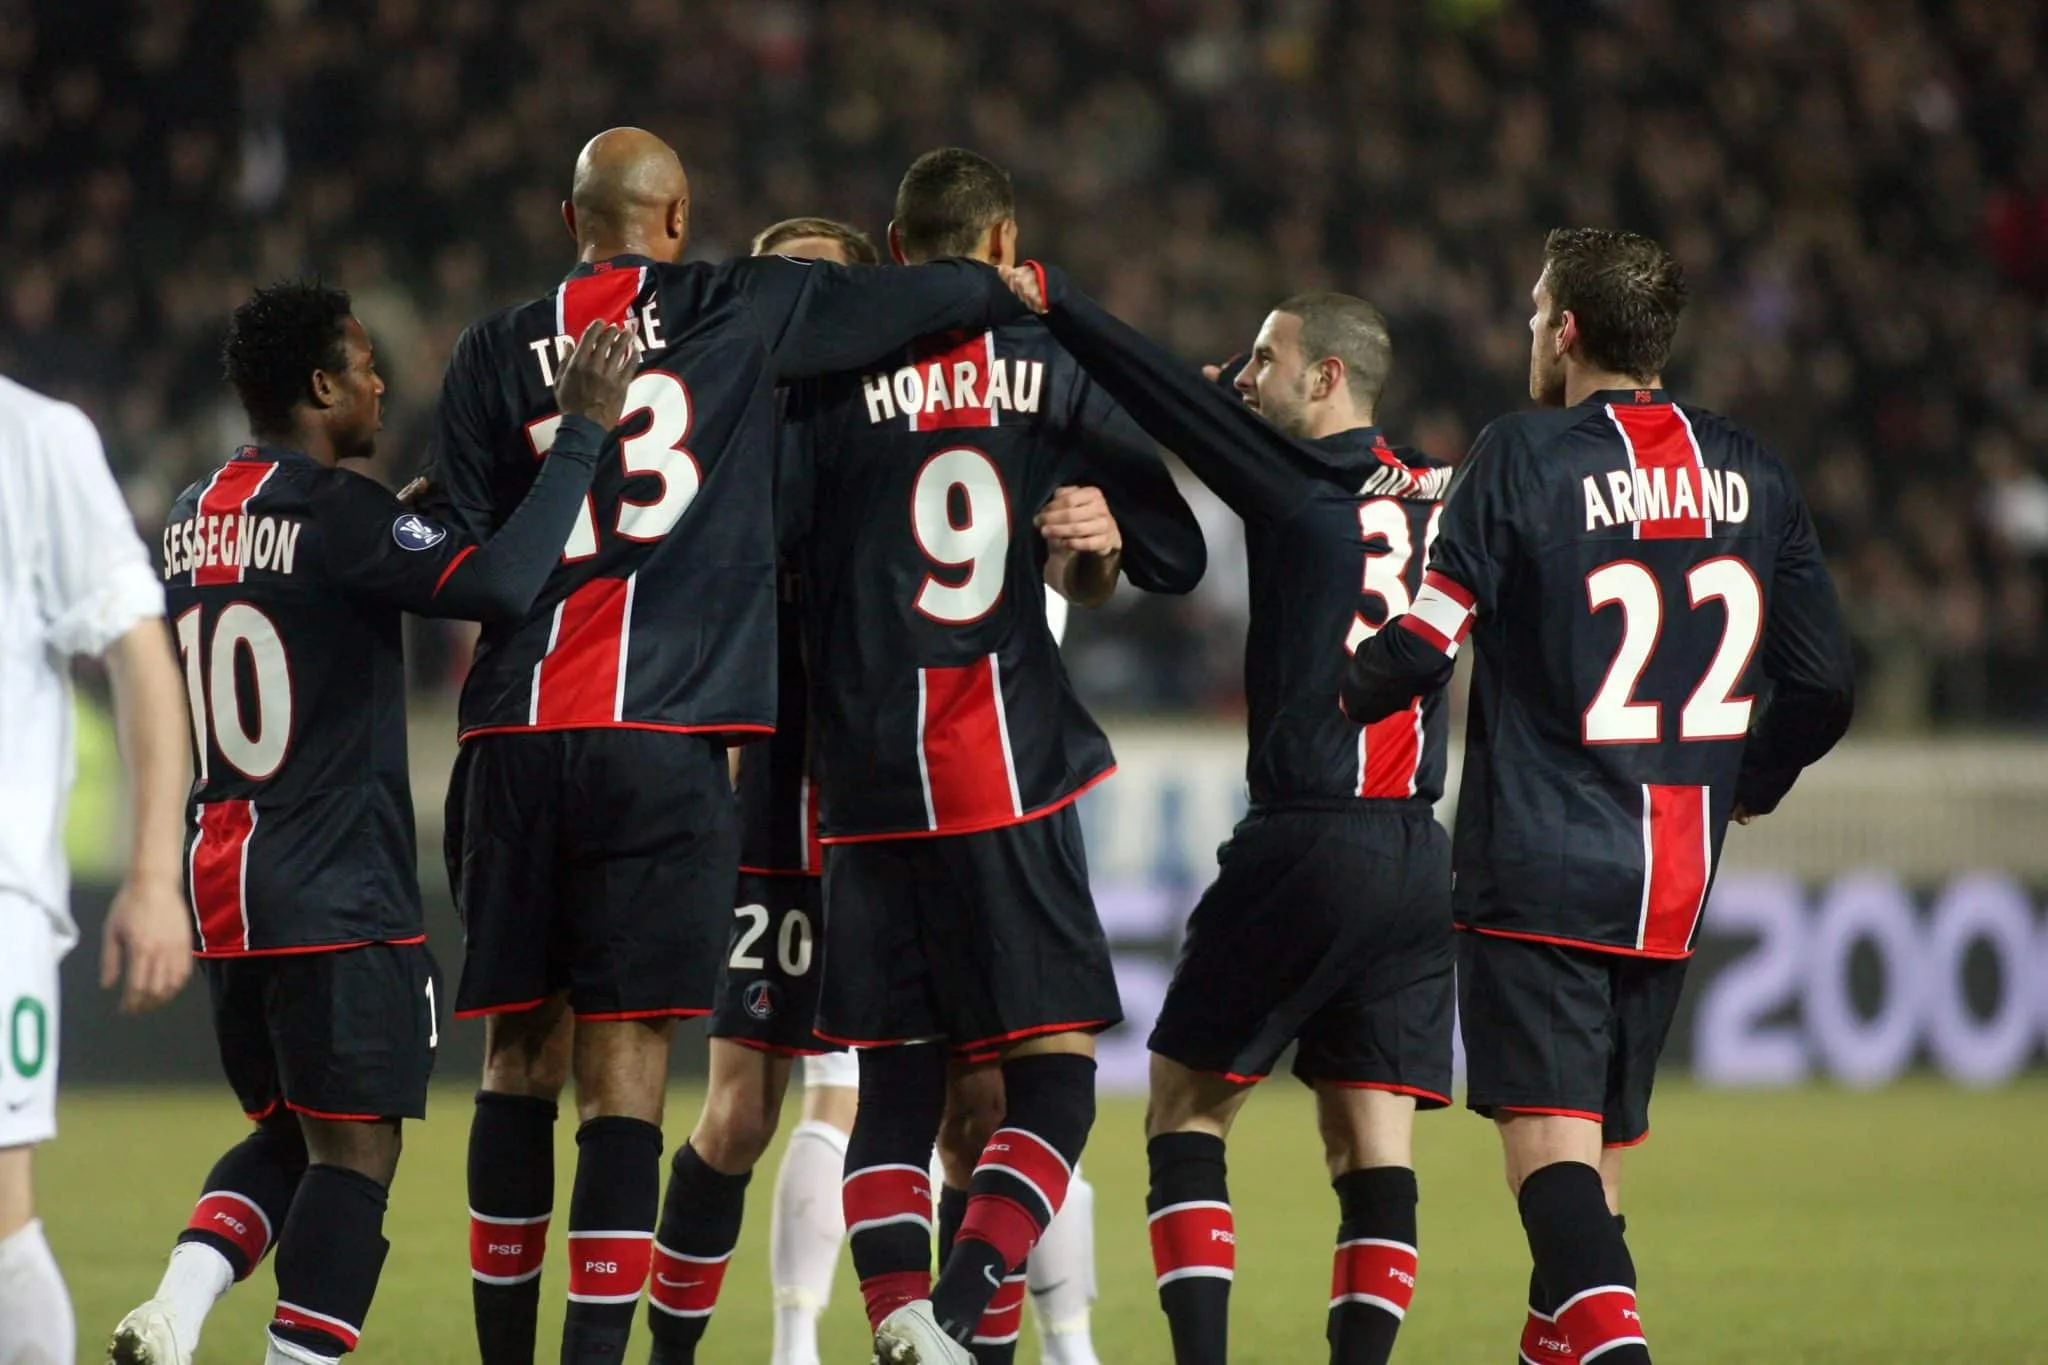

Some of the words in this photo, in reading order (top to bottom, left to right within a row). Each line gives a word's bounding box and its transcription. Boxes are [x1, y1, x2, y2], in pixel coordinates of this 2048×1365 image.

[861, 358, 1044, 424] HOARAU
[1582, 465, 1750, 532] ARMAND
[163, 513, 302, 581] SESSEGNON
[910, 445, 1012, 625] 9
[1344, 495, 1444, 658] 3
[1582, 555, 1764, 746] 22
[174, 600, 295, 784] 10
[729, 903, 813, 976] 20
[1694, 868, 2048, 1091] 200
[213, 1211, 247, 1235] PSG
[488, 1244, 523, 1256] PSG
[585, 1261, 618, 1274] PSG
[1538, 1334, 1572, 1354] PSG
